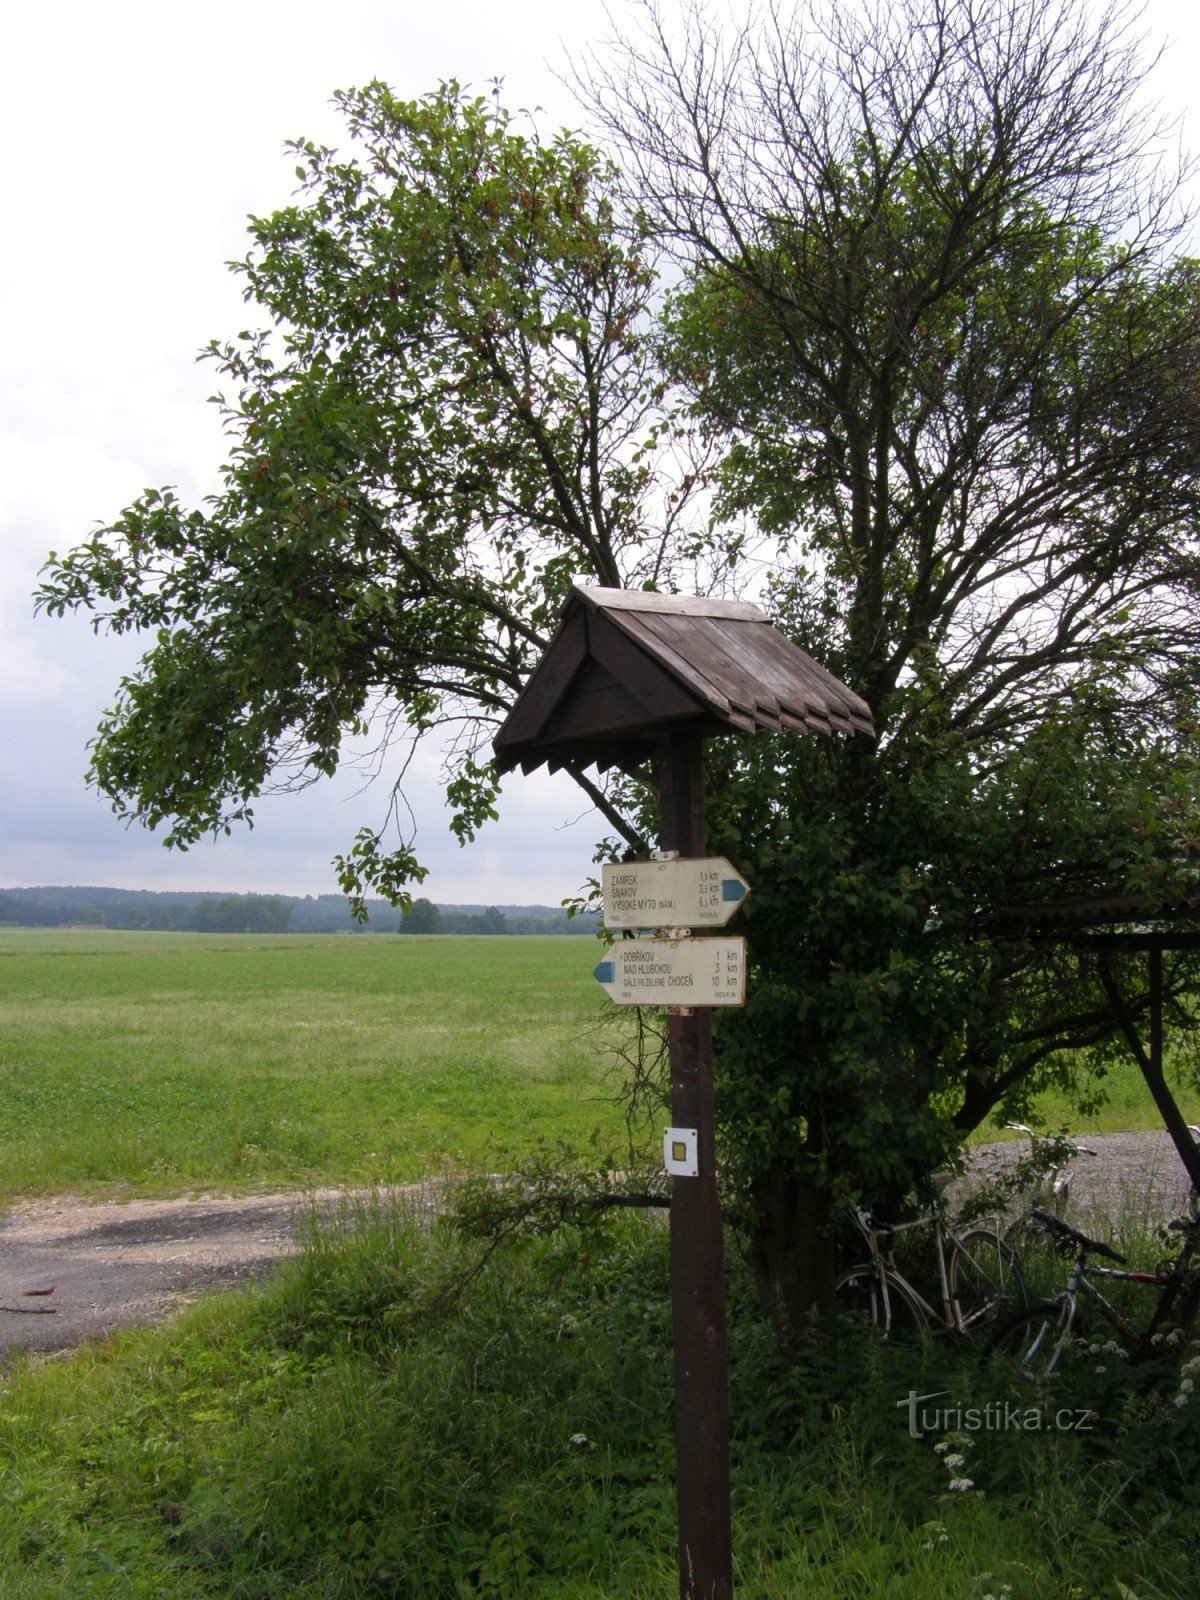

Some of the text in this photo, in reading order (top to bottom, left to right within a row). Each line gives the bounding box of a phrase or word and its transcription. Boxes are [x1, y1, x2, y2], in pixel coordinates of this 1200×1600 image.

[611, 874, 638, 886] ZÁMRSK
[709, 871, 719, 881] km
[709, 883, 719, 893] km
[638, 897, 656, 910] MÝTO
[709, 896, 719, 907] km
[623, 949, 738, 962] DOBŘÍKOV 1 km
[623, 962, 738, 975] NAD HLUBOKOU 3 km
[623, 973, 738, 987] DÁLE PO ZELENÉ CHOCEŇ 10 km
